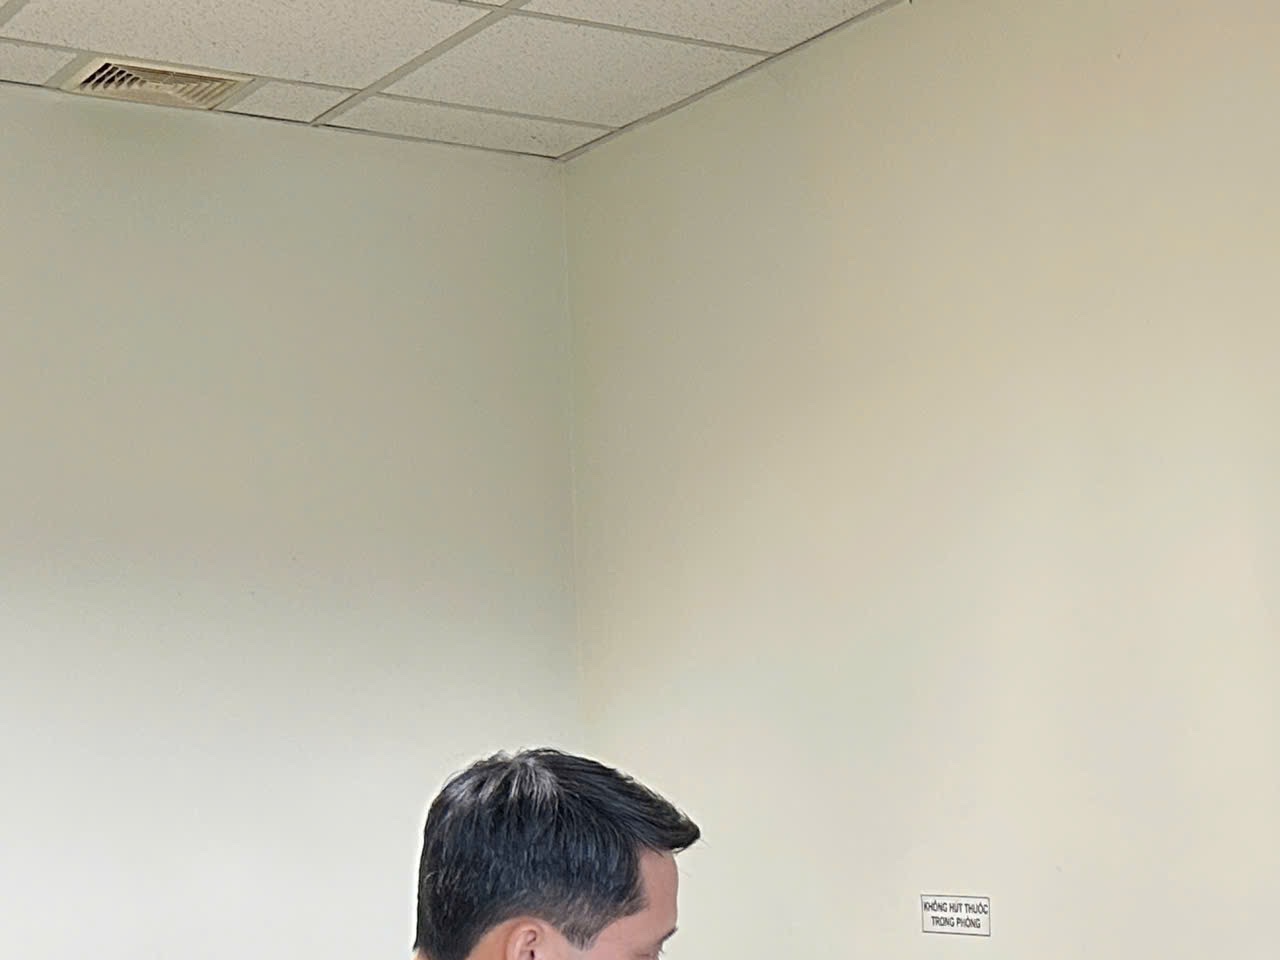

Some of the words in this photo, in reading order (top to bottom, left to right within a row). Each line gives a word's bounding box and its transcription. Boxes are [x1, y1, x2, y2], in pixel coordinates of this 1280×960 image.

[924, 900, 947, 913] KHÔNG
[964, 902, 988, 914] THUỐC
[931, 916, 955, 928] TRONG
[956, 915, 981, 929] PHÒNG
